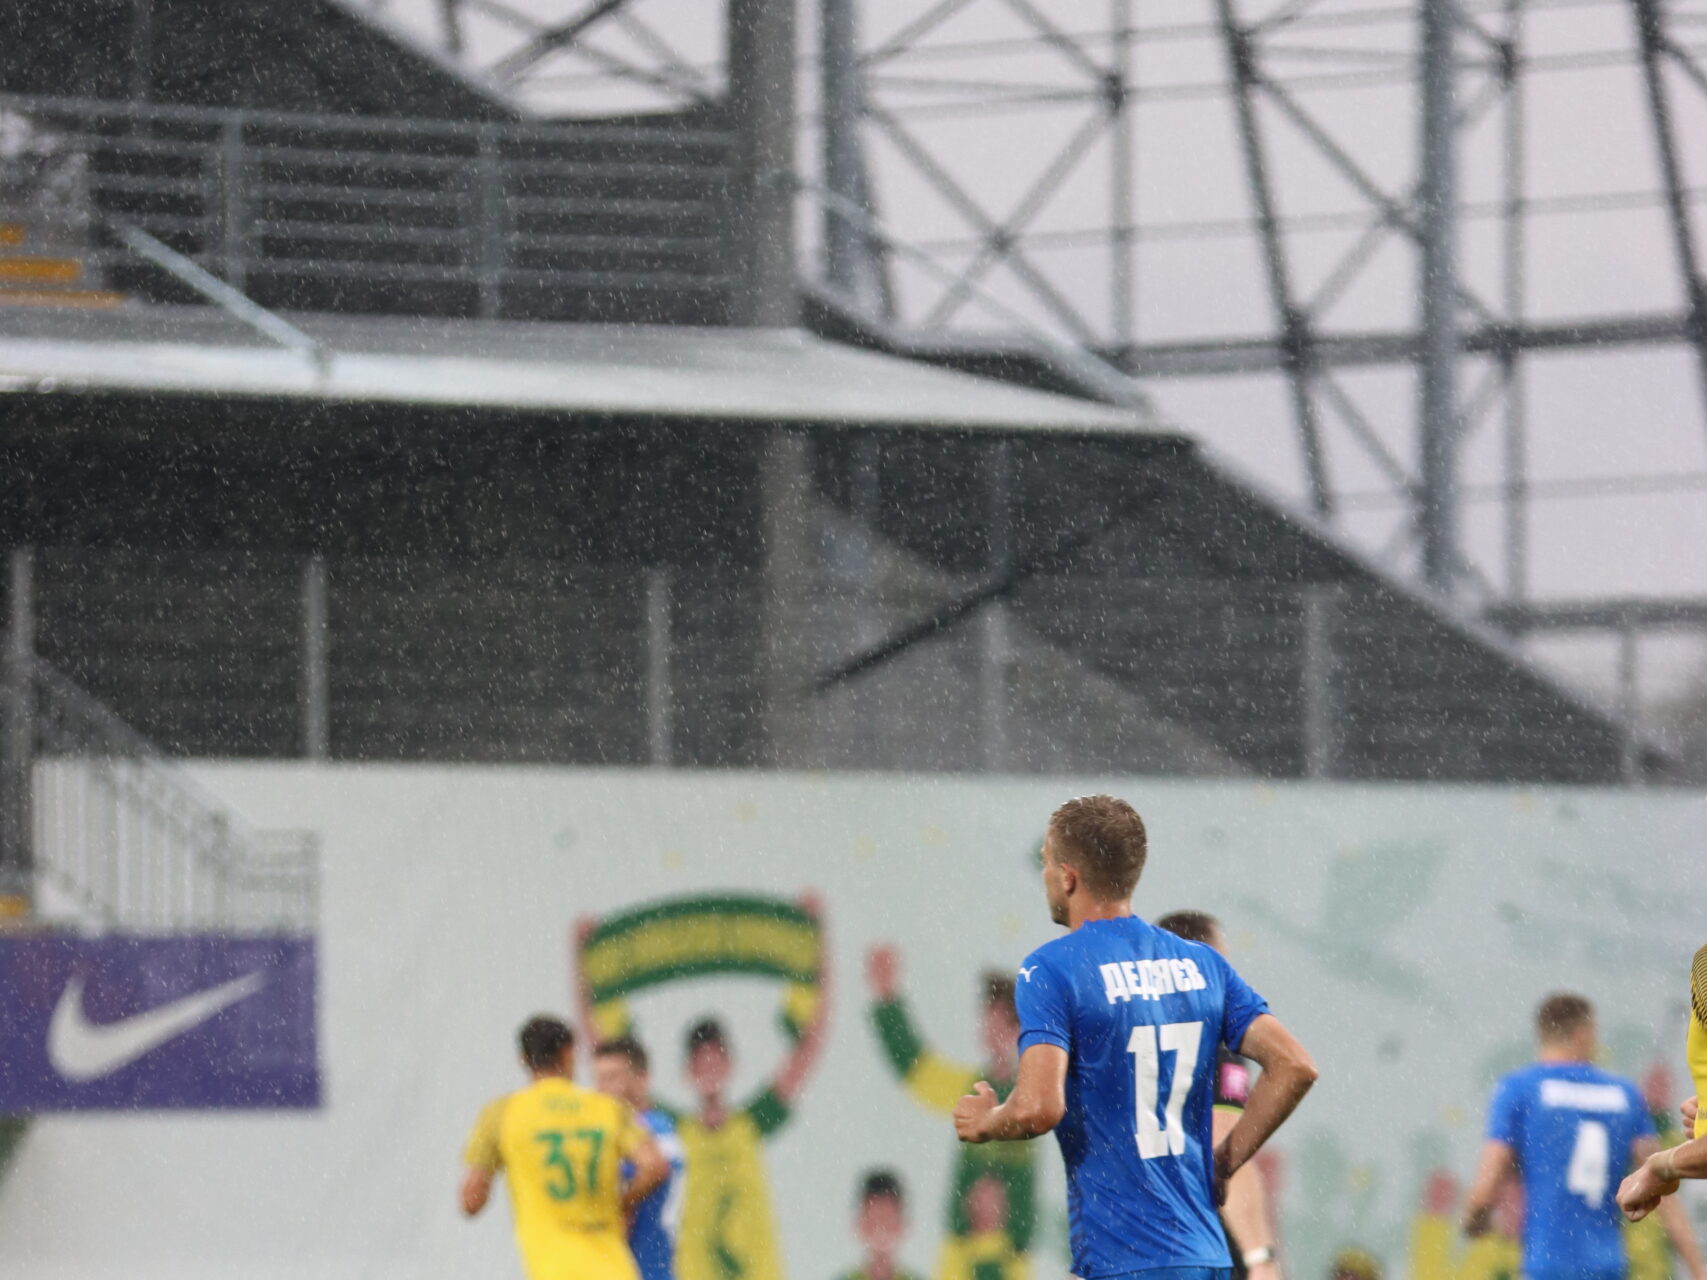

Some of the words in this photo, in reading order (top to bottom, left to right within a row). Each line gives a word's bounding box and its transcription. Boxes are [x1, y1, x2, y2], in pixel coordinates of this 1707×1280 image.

[1127, 1021, 1202, 1159] 17
[535, 1129, 604, 1202] 37
[1566, 1119, 1610, 1210] 4
